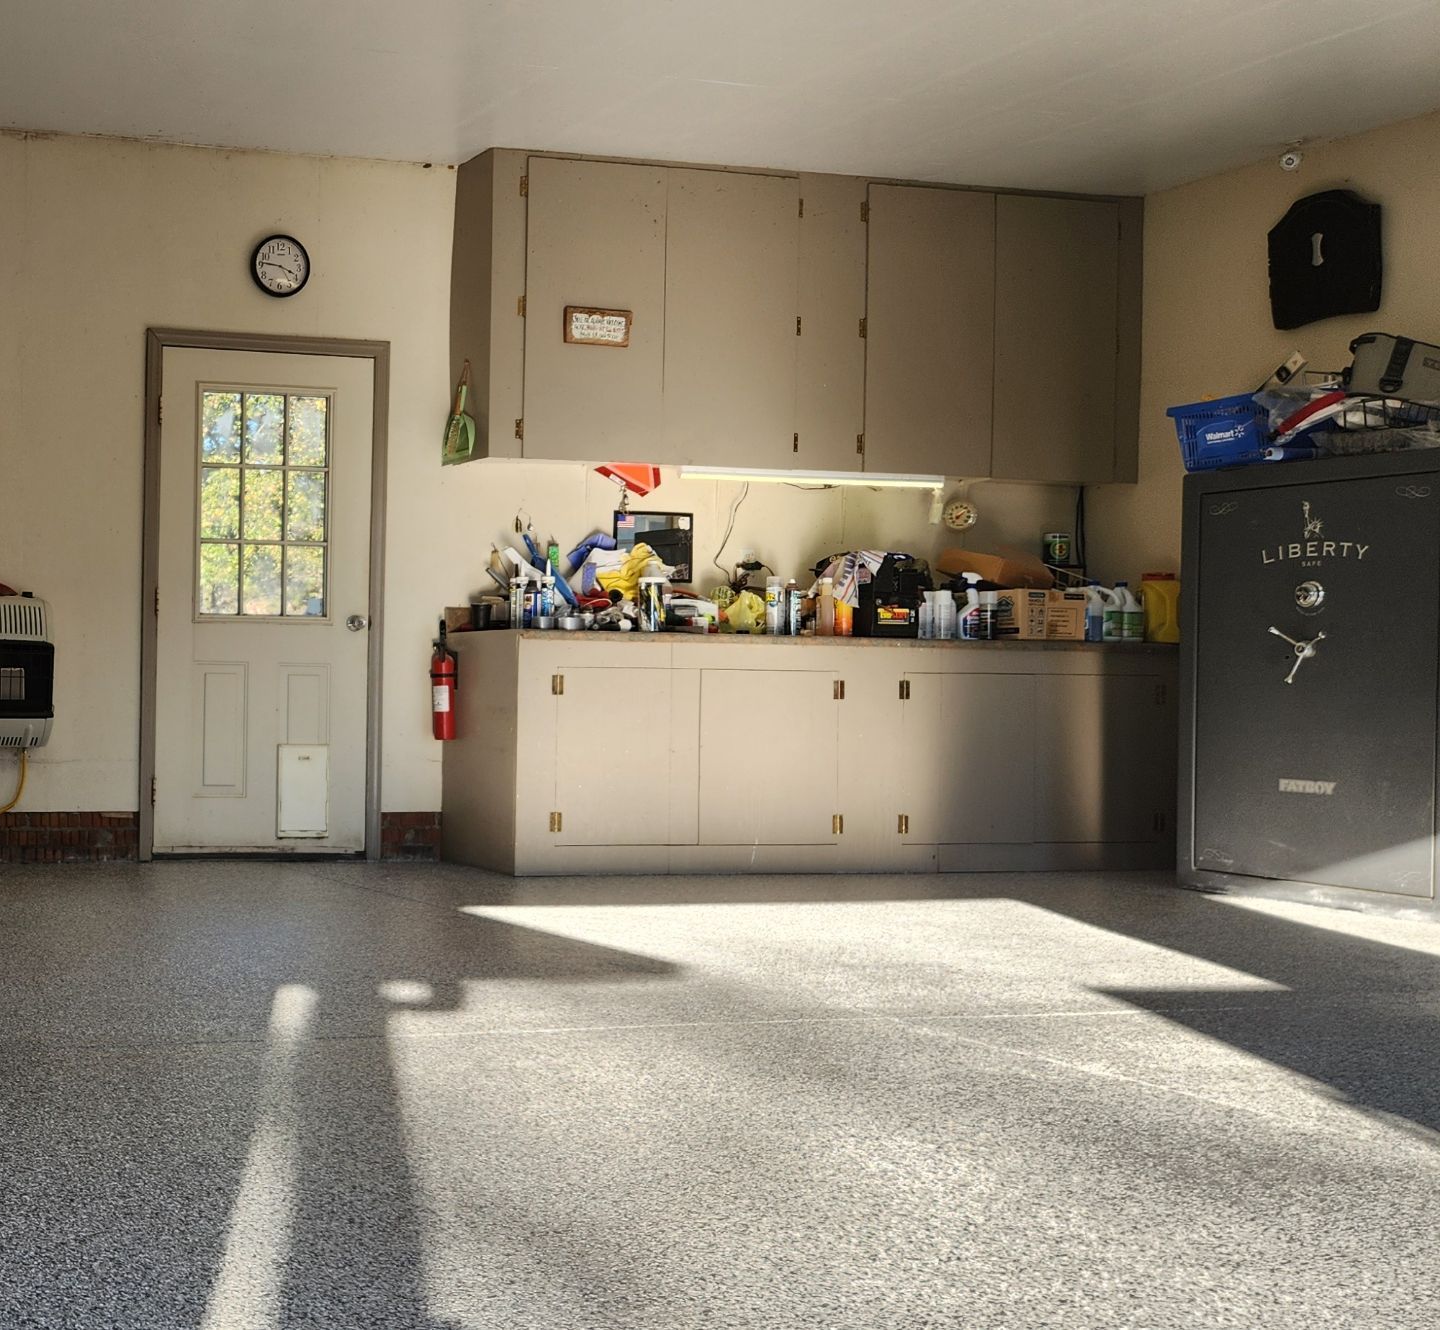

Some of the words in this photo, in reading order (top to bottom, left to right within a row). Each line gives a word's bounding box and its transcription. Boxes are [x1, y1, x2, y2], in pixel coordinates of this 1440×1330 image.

[268, 245, 275, 254] 11
[277, 242, 285, 251] 12
[261, 252, 270, 261] 10
[294, 253, 299, 262] 2
[297, 264, 302, 272] 3
[261, 271, 267, 280] 8
[268, 278, 273, 287] 7
[277, 282, 282, 290] 6
[1205, 430, 1234, 441] Walmart
[1262, 541, 1369, 564] LIBERTY
[1279, 778, 1336, 795] FATBOY
